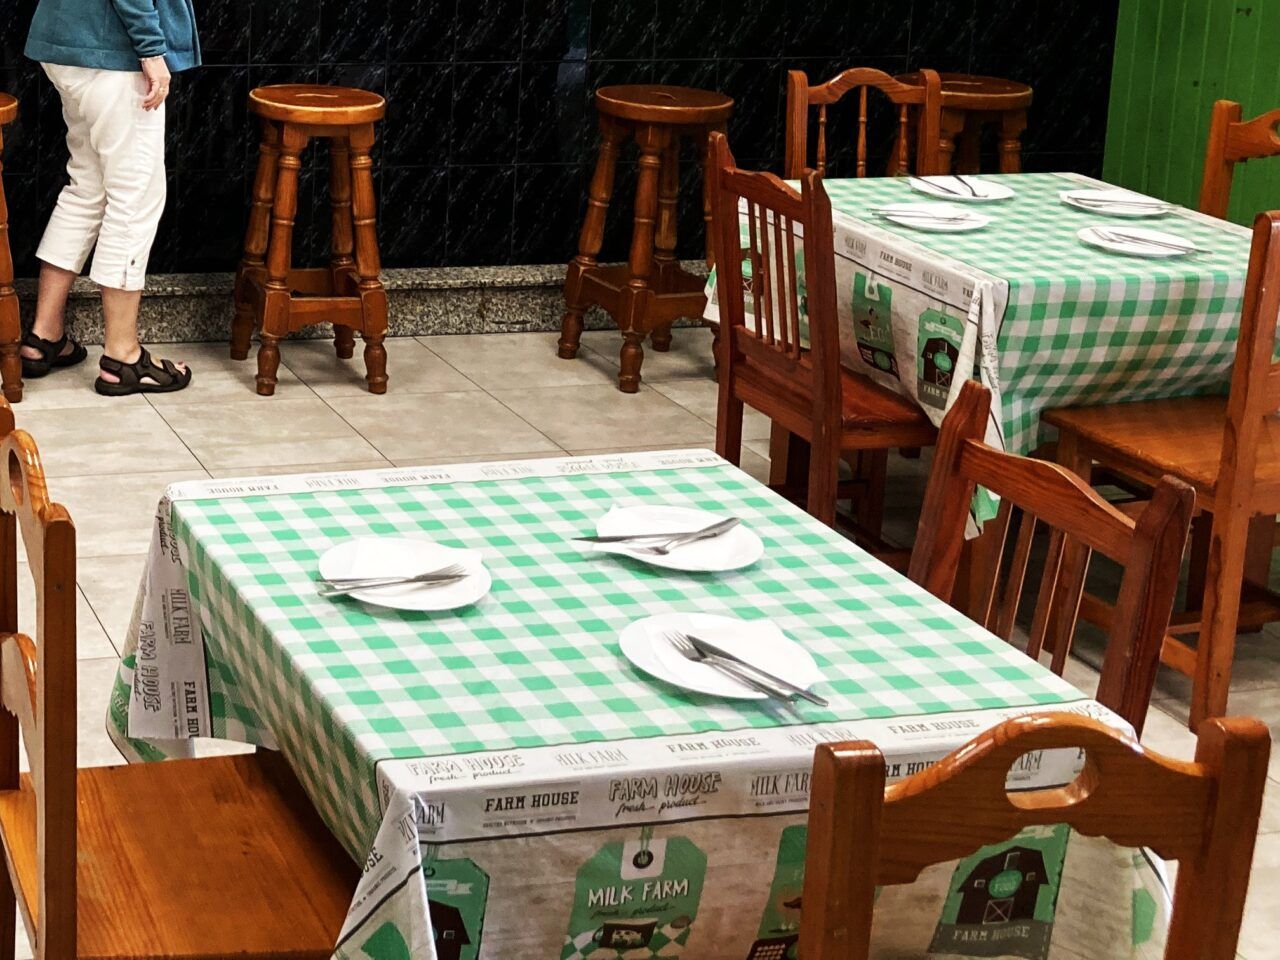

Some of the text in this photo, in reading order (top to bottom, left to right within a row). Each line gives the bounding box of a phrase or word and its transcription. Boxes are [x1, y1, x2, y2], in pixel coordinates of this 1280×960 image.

[141, 665, 162, 714] HOUSE
[184, 681, 198, 714] FARM
[887, 719, 980, 735] FARM HOUSE
[667, 737, 761, 753] FARM HOUSE
[406, 753, 525, 776] FARM HOUSE
[428, 768, 520, 784] fresh product
[609, 771, 722, 802] FARM HOUSE
[749, 772, 811, 796] MILK FAR
[484, 791, 580, 813] FARM HOUSE
[658, 797, 707, 813] product
[587, 878, 689, 908] MILK FARM
[953, 926, 1030, 941] FARM HOUSE
